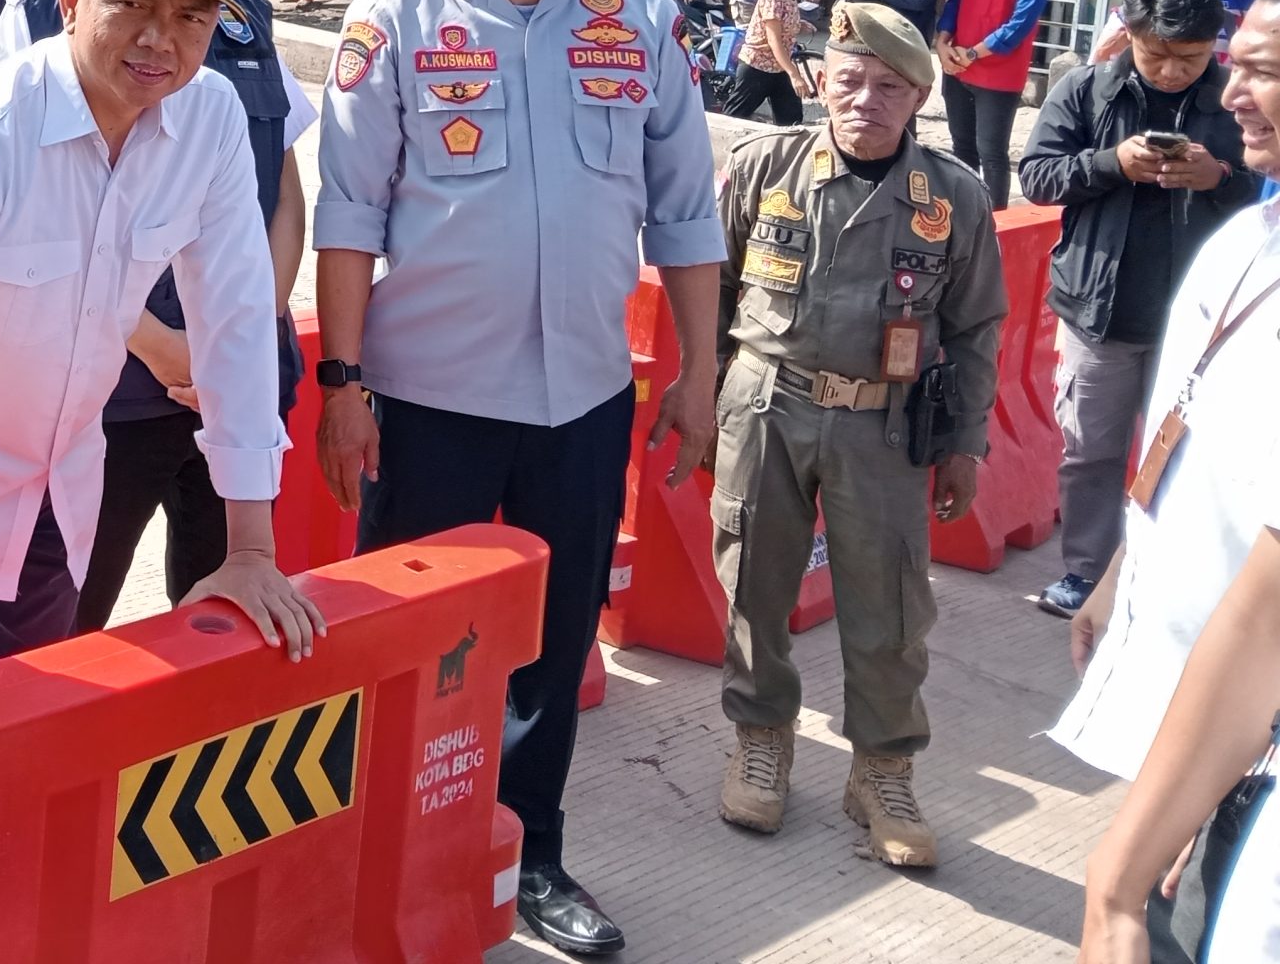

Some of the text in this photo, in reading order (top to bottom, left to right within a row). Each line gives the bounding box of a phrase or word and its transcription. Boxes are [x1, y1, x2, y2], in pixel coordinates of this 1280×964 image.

[420, 54, 491, 68] A.KUSWARA
[573, 51, 641, 66] DISHUB
[423, 724, 480, 764] DISHUB
[415, 747, 484, 793] KOTA BDG
